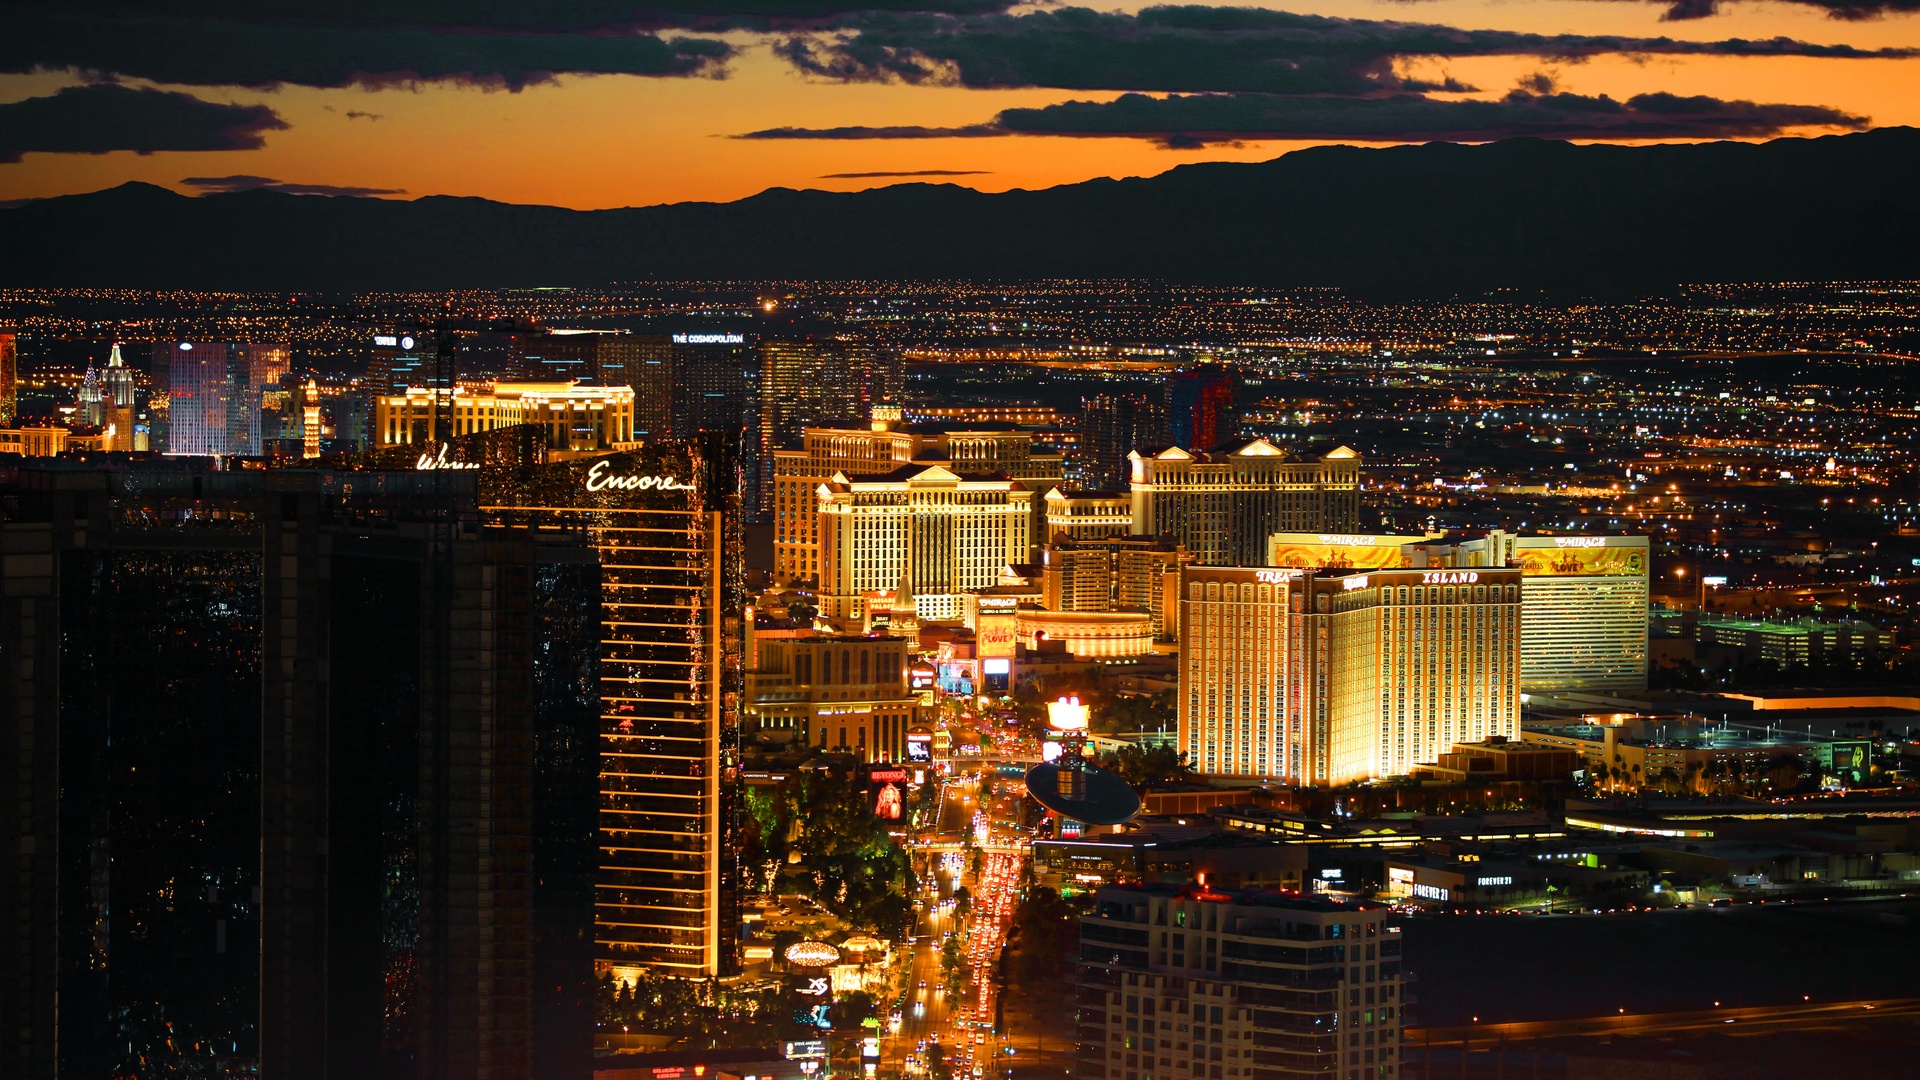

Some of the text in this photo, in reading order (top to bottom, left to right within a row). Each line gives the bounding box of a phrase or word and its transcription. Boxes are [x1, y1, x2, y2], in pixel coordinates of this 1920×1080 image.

[672, 334, 744, 343] THE COSMOPOLITAN
[586, 460, 697, 491] Encore
[1323, 535, 1376, 546] MIRAGE
[1559, 537, 1606, 548] MIRAGE
[1285, 556, 1309, 566] BEATLES
[1555, 564, 1579, 572] LOVE
[1422, 572, 1479, 583] ISLAND
[981, 598, 1017, 607] MIRAGE
[987, 635, 1008, 643] LOVE
[1478, 876, 1512, 886] FOREVER 21
[1414, 883, 1449, 901] FOREVER 21
[808, 977, 829, 995] XS
